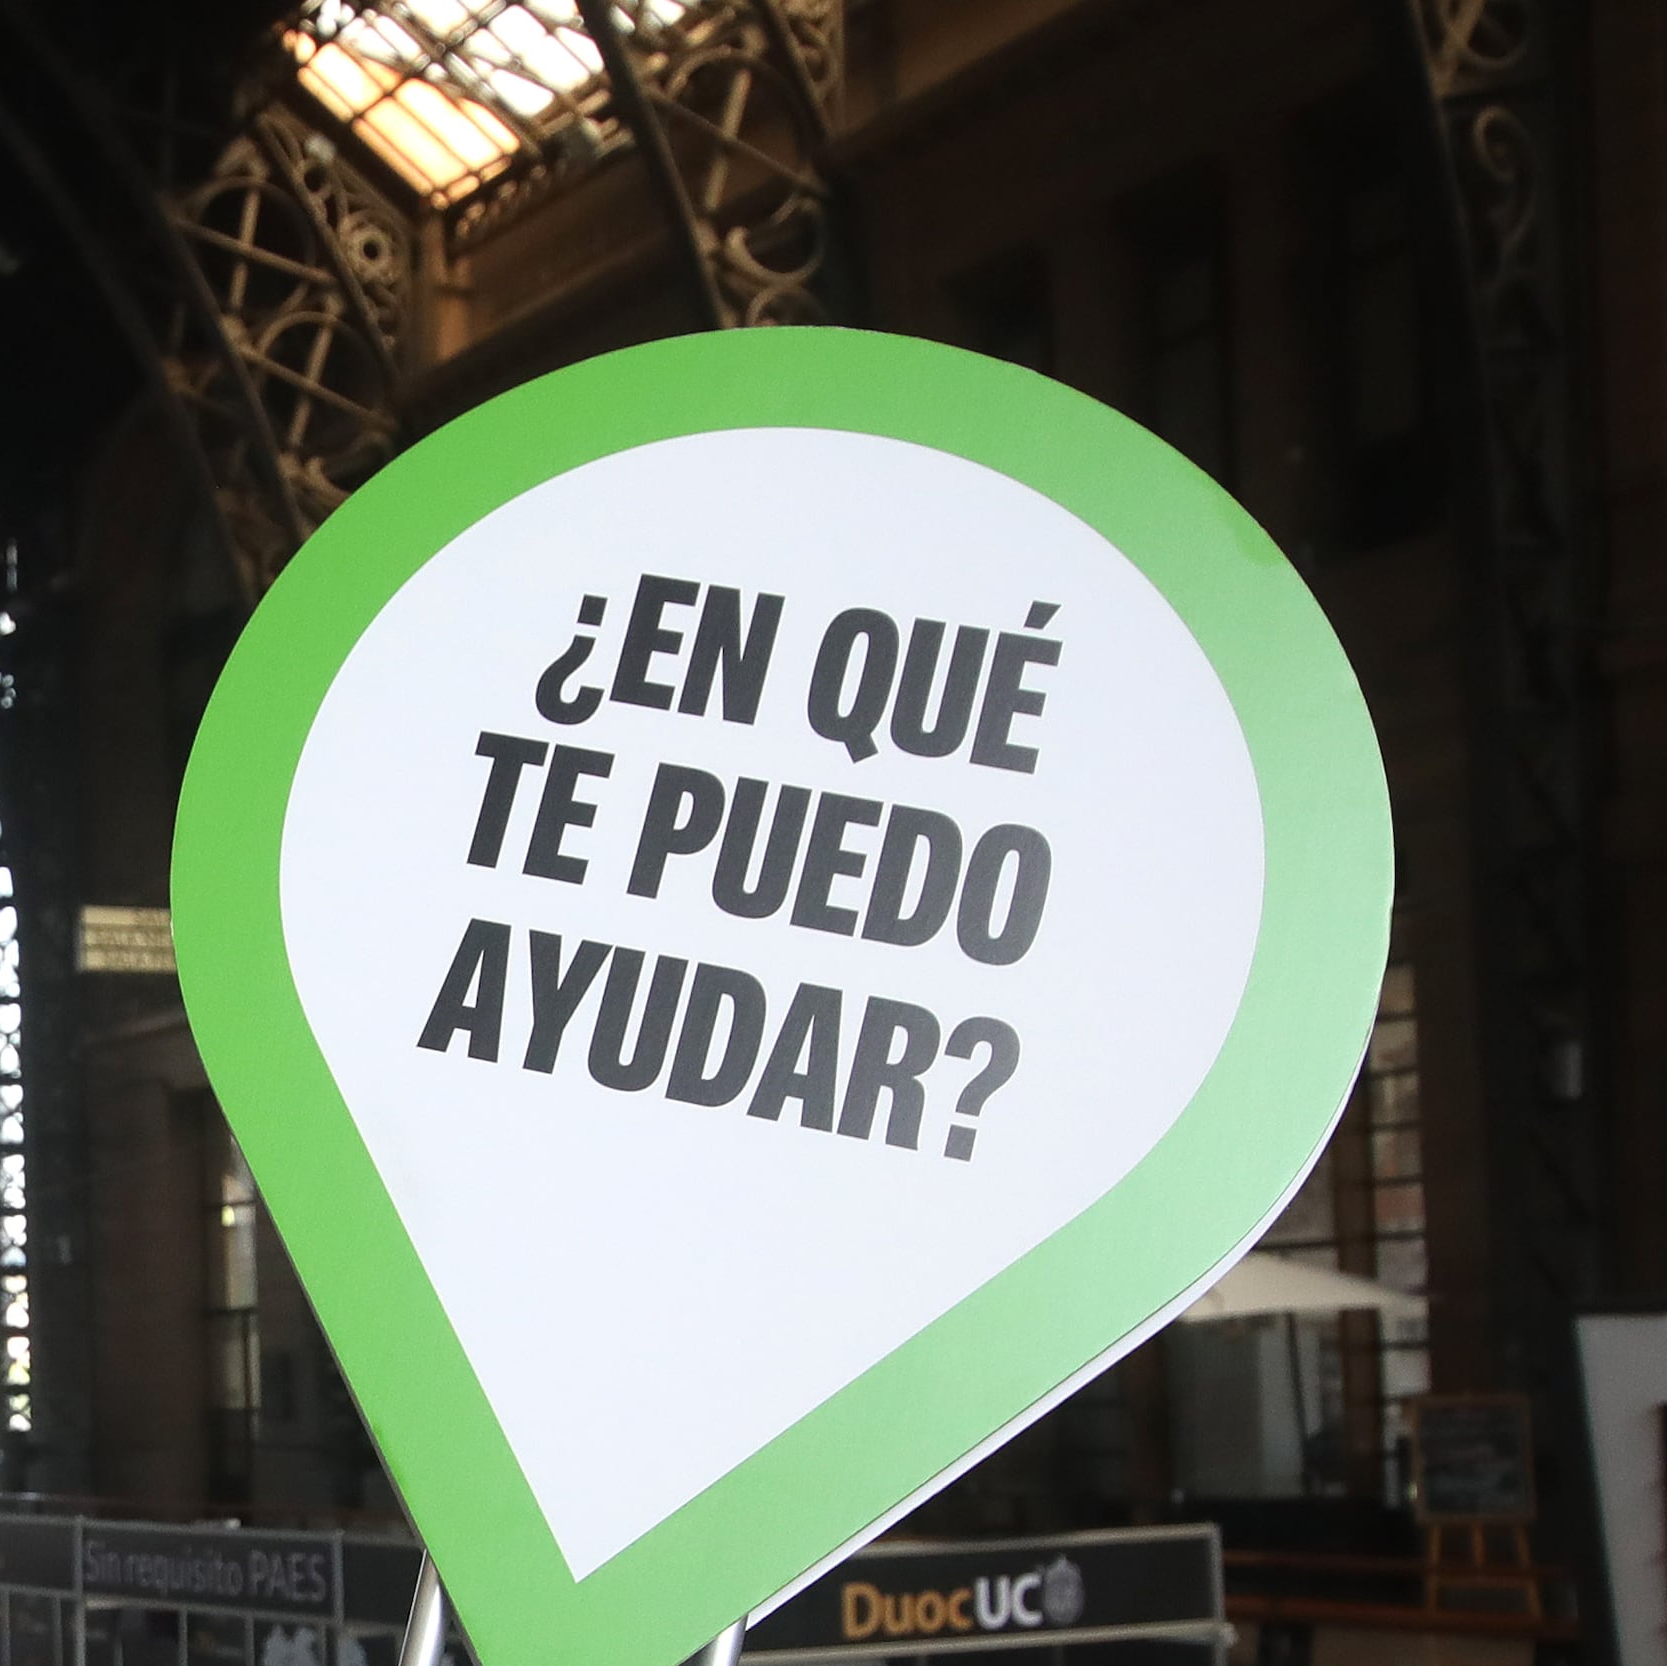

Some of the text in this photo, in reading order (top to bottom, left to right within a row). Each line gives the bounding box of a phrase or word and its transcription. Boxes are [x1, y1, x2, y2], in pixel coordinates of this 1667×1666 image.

[535, 573, 1063, 775] ¿EN QUÉ
[467, 731, 1053, 967] TE PUEDO
[416, 918, 1021, 1162] AYUDAR?
[247, 1549, 328, 1602] PAES
